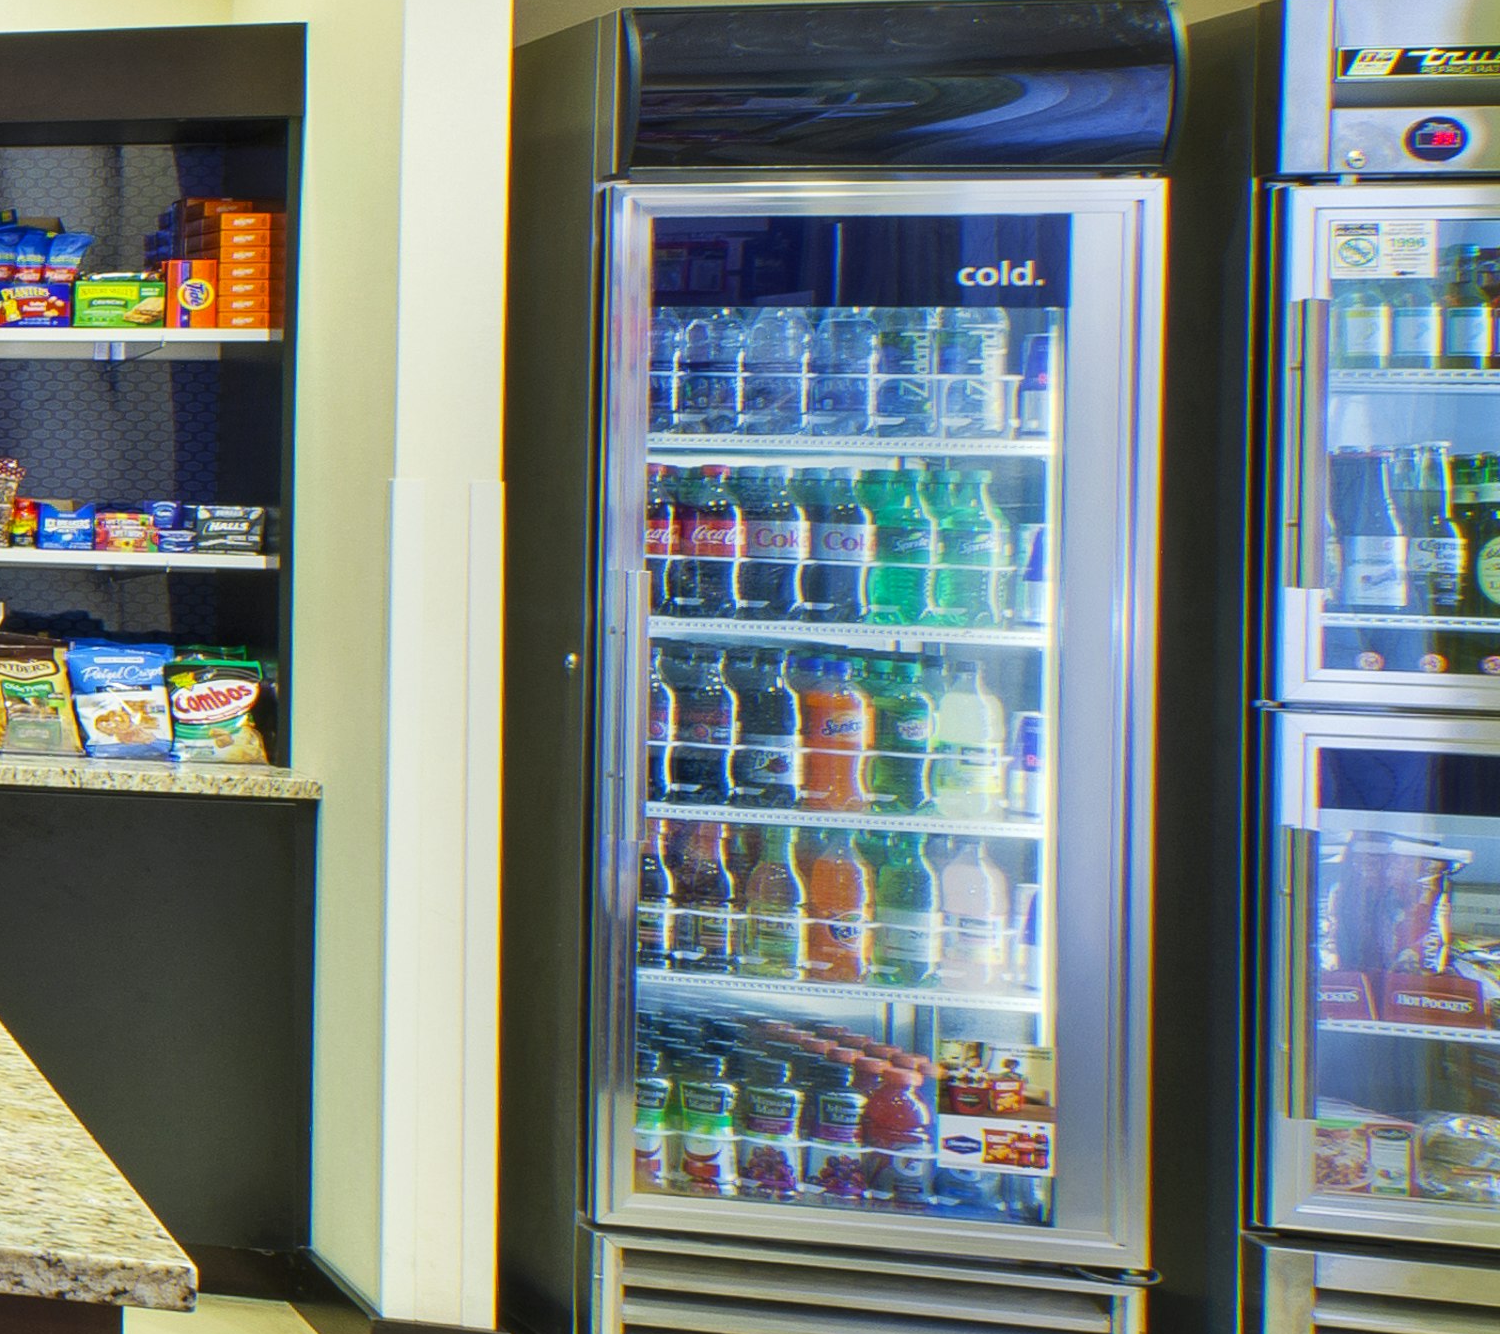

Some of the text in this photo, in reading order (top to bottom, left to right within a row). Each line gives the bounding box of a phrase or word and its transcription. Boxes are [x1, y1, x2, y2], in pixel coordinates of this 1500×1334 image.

[956, 260, 1046, 286] cold.
[209, 521, 249, 532] HALLS
[174, 682, 253, 714] Combos
